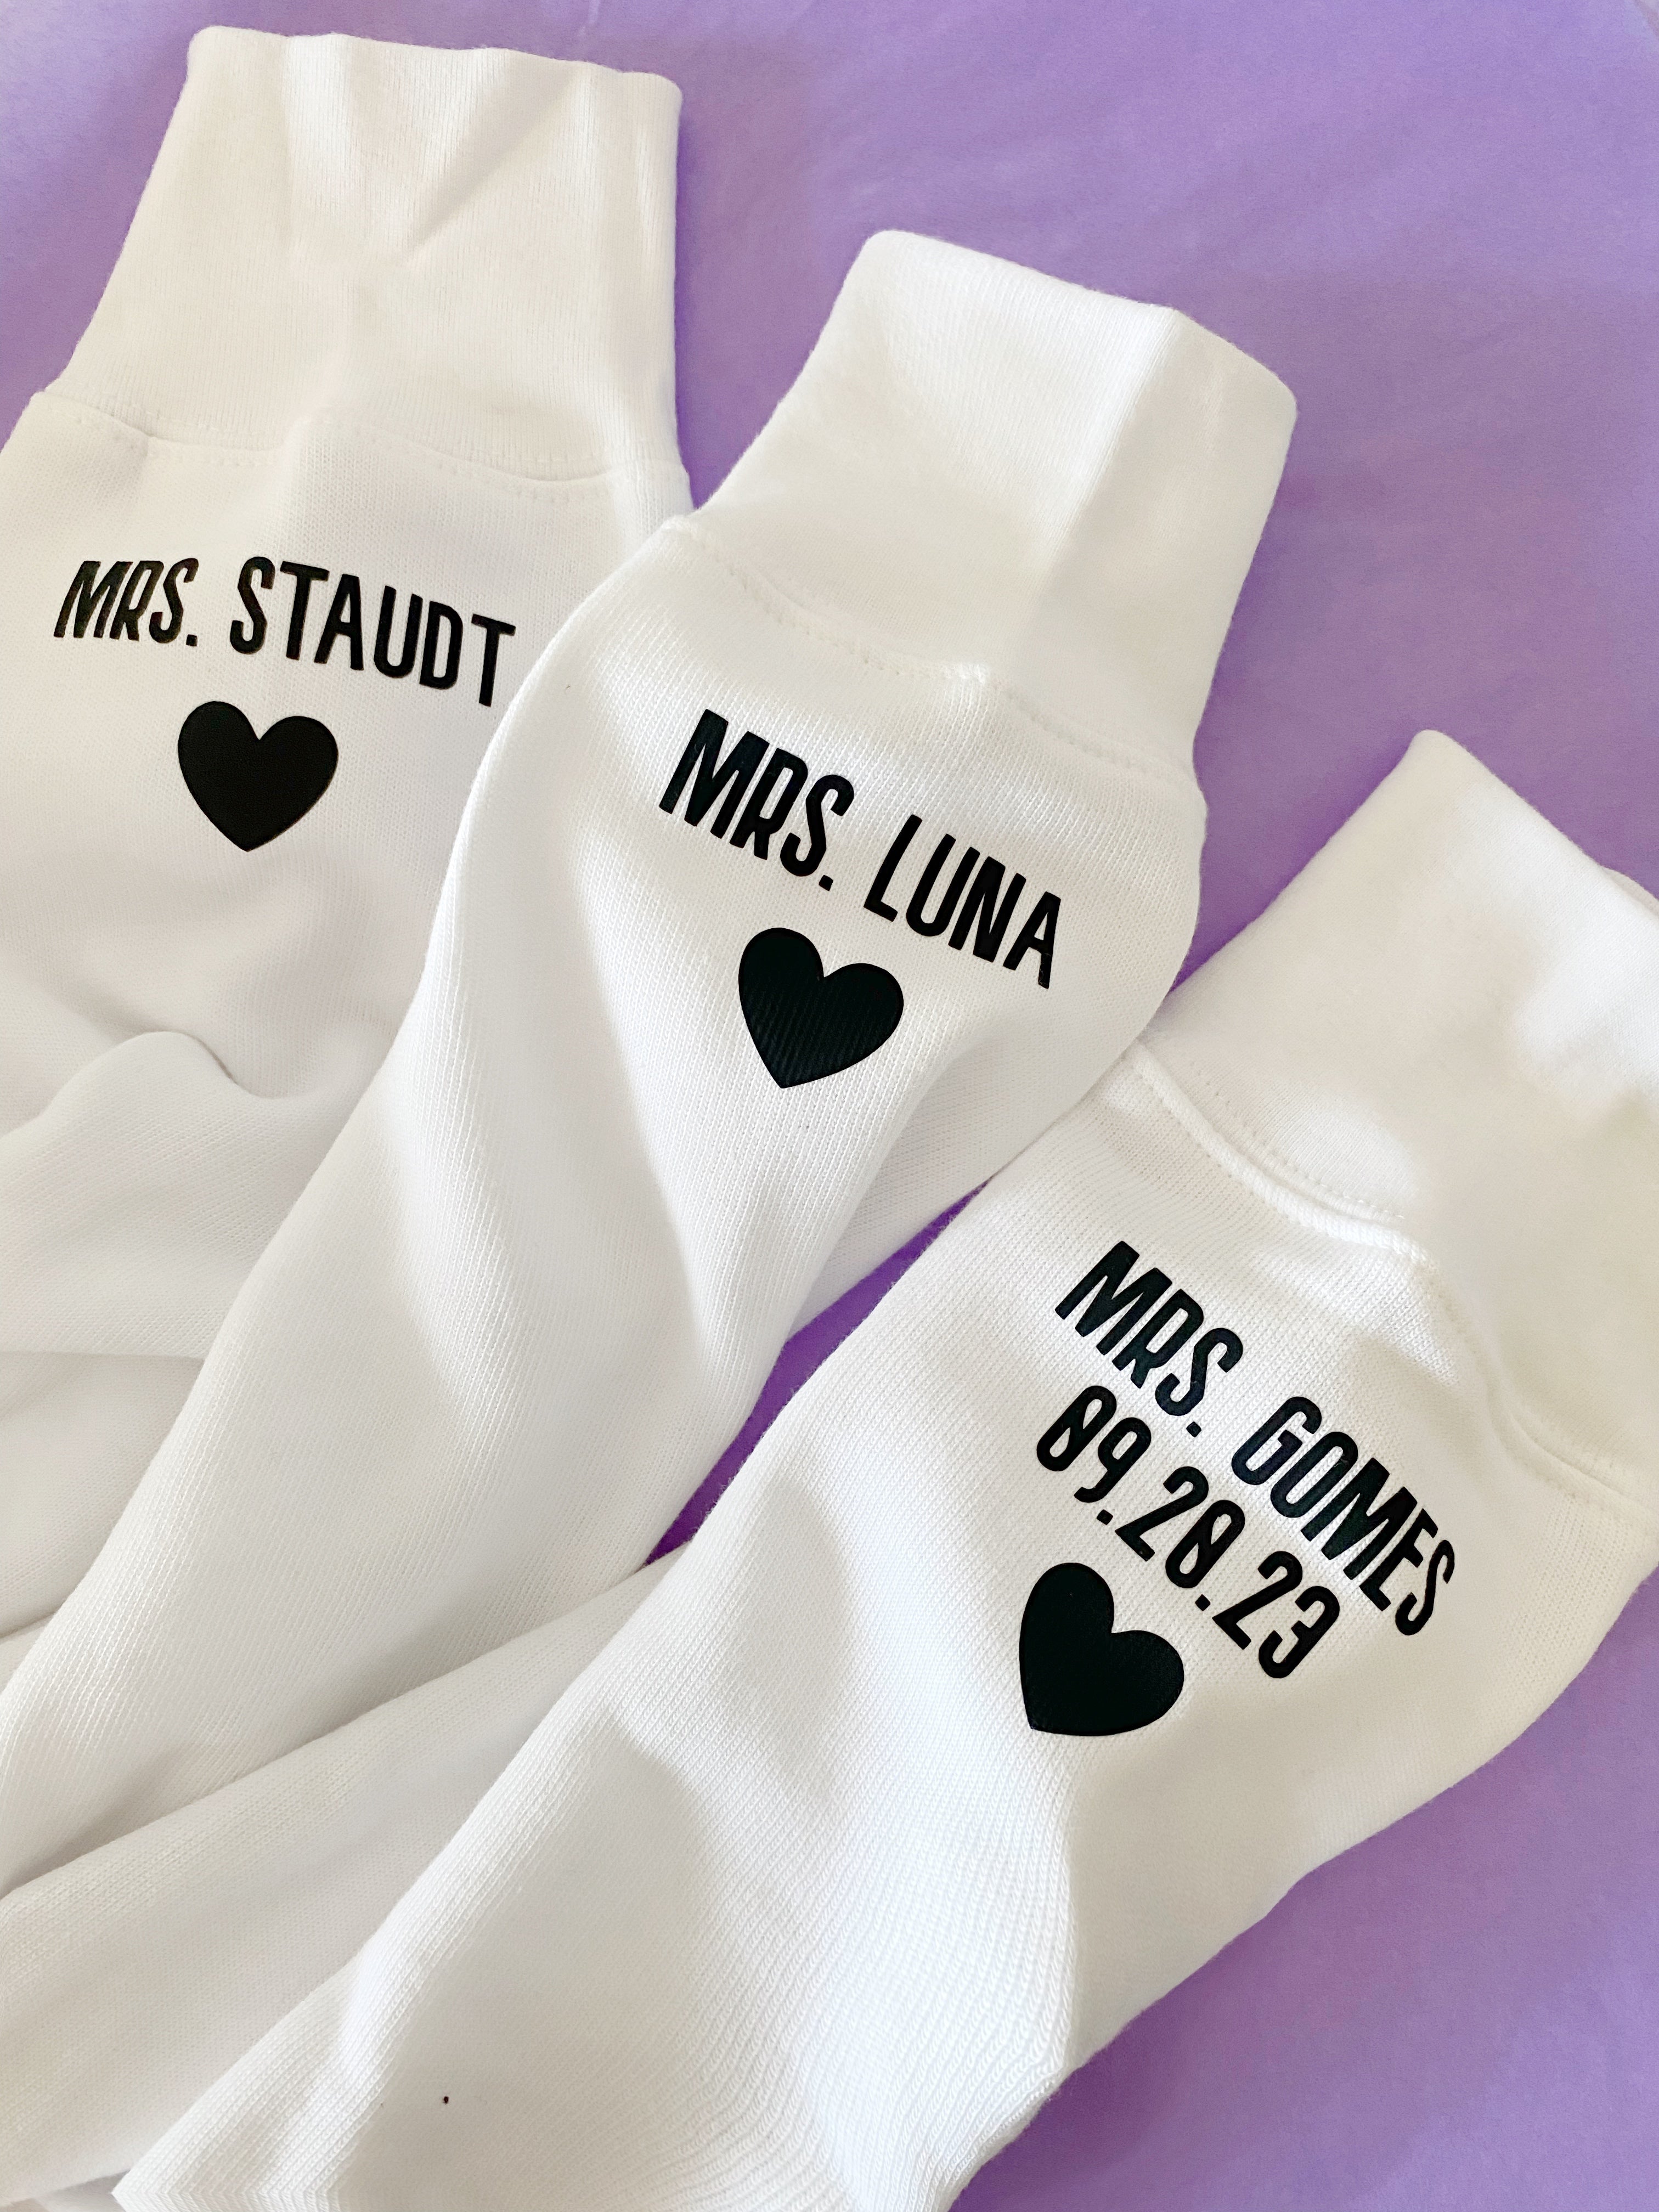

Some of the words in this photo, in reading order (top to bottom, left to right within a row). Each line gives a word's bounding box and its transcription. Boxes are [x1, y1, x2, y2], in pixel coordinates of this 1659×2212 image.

[53, 557, 199, 647] MRS.
[229, 556, 516, 708] STAUDT
[659, 709, 854, 891] MRS.
[863, 814, 1062, 990] LUNA
[1036, 1385, 1340, 1679] 09.20.23
[1054, 1240, 1243, 1438] MRS.
[1231, 1396, 1455, 1636] GOMES
